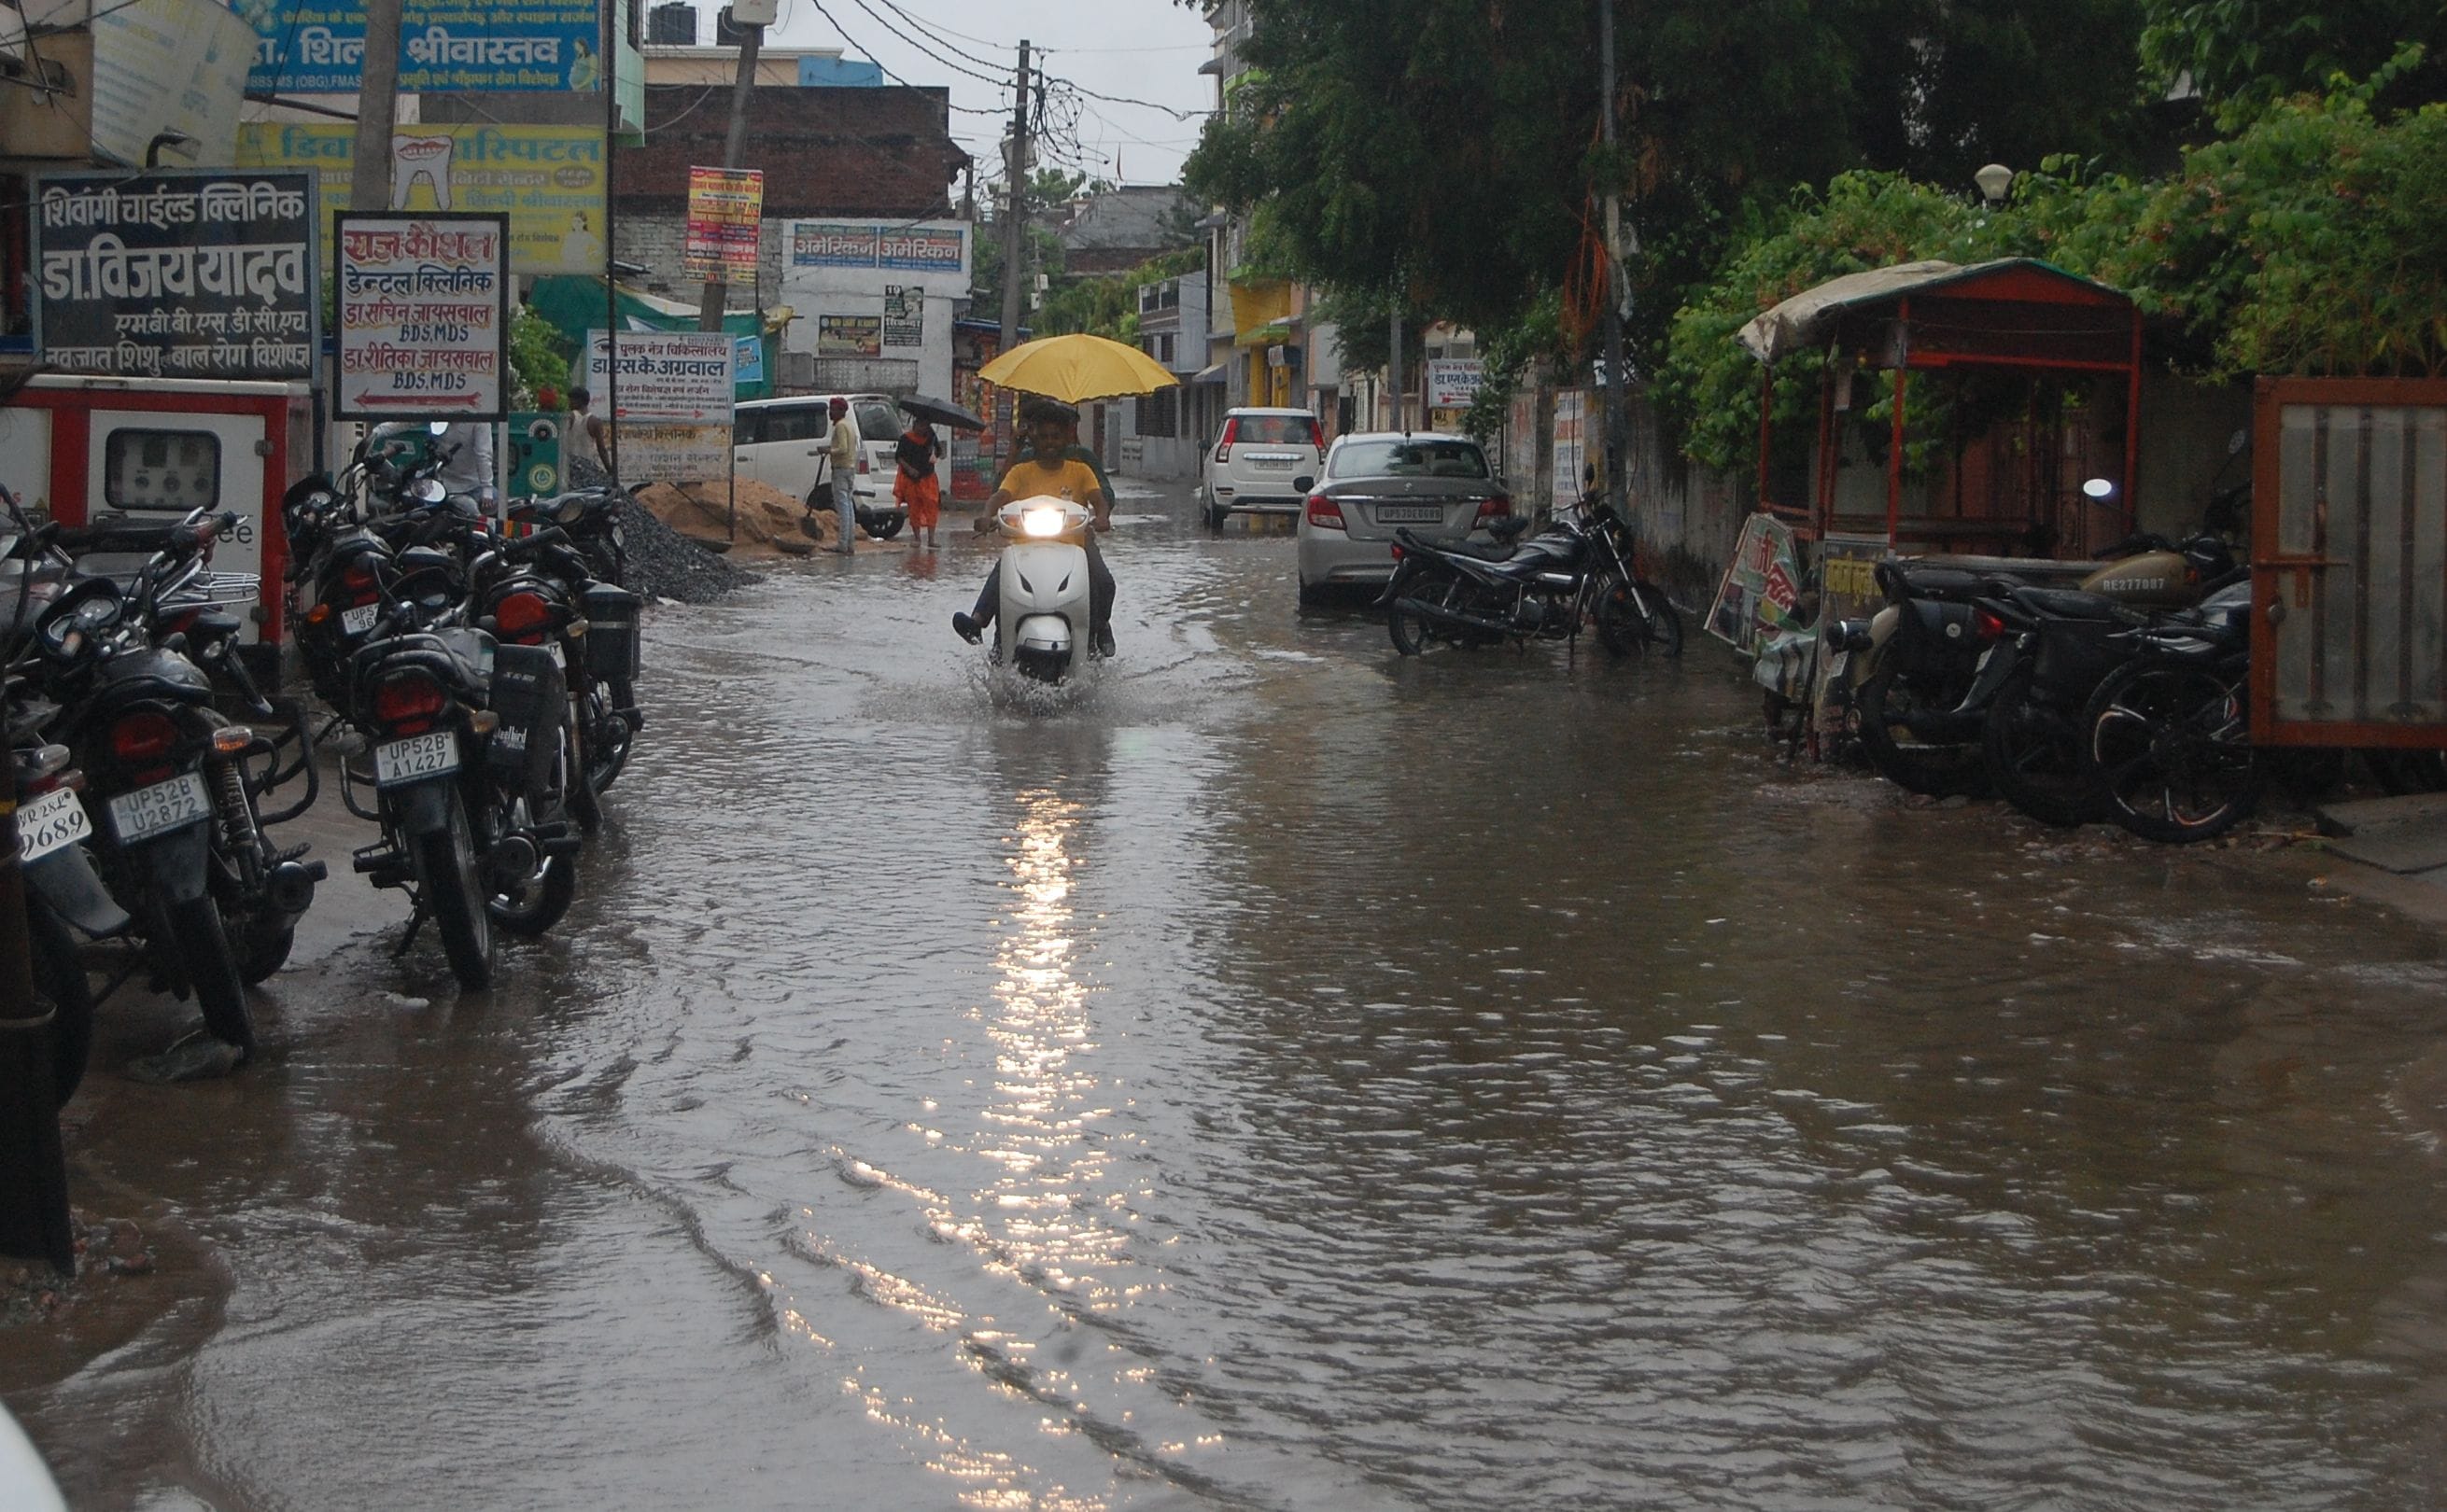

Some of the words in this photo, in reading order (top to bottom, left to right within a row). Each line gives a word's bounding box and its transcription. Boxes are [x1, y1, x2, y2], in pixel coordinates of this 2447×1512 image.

[407, 25, 560, 64] श्रीवास्तव
[41, 187, 120, 227] शिवांगी
[121, 184, 198, 231] चाईल्ड
[202, 181, 304, 221] क्लिनिक
[344, 230, 404, 263] राज
[795, 236, 875, 256] अमेरिकन
[880, 238, 960, 259] अमेरिकन
[197, 243, 306, 305] यादव
[345, 264, 415, 295] डेन्टल
[416, 264, 494, 295] क्लिनिक
[411, 303, 493, 325] जायसवाल
[46, 346, 114, 370] नवजात
[116, 340, 162, 376] शिशु
[171, 344, 211, 370] बाल
[212, 338, 249, 370] रोग
[252, 337, 310, 370] विशेषज्ञ
[418, 348, 496, 371] जायसवाल
[620, 343, 645, 357] पुलक
[648, 341, 664, 356] नेत्र
[667, 342, 727, 357] चिकित्सालय
[641, 385, 671, 395] विशेषज्ञ
[390, 734, 445, 760] UP52B
[393, 752, 445, 777] A1427
[126, 778, 191, 811] UP52B
[133, 797, 199, 831] U2872
